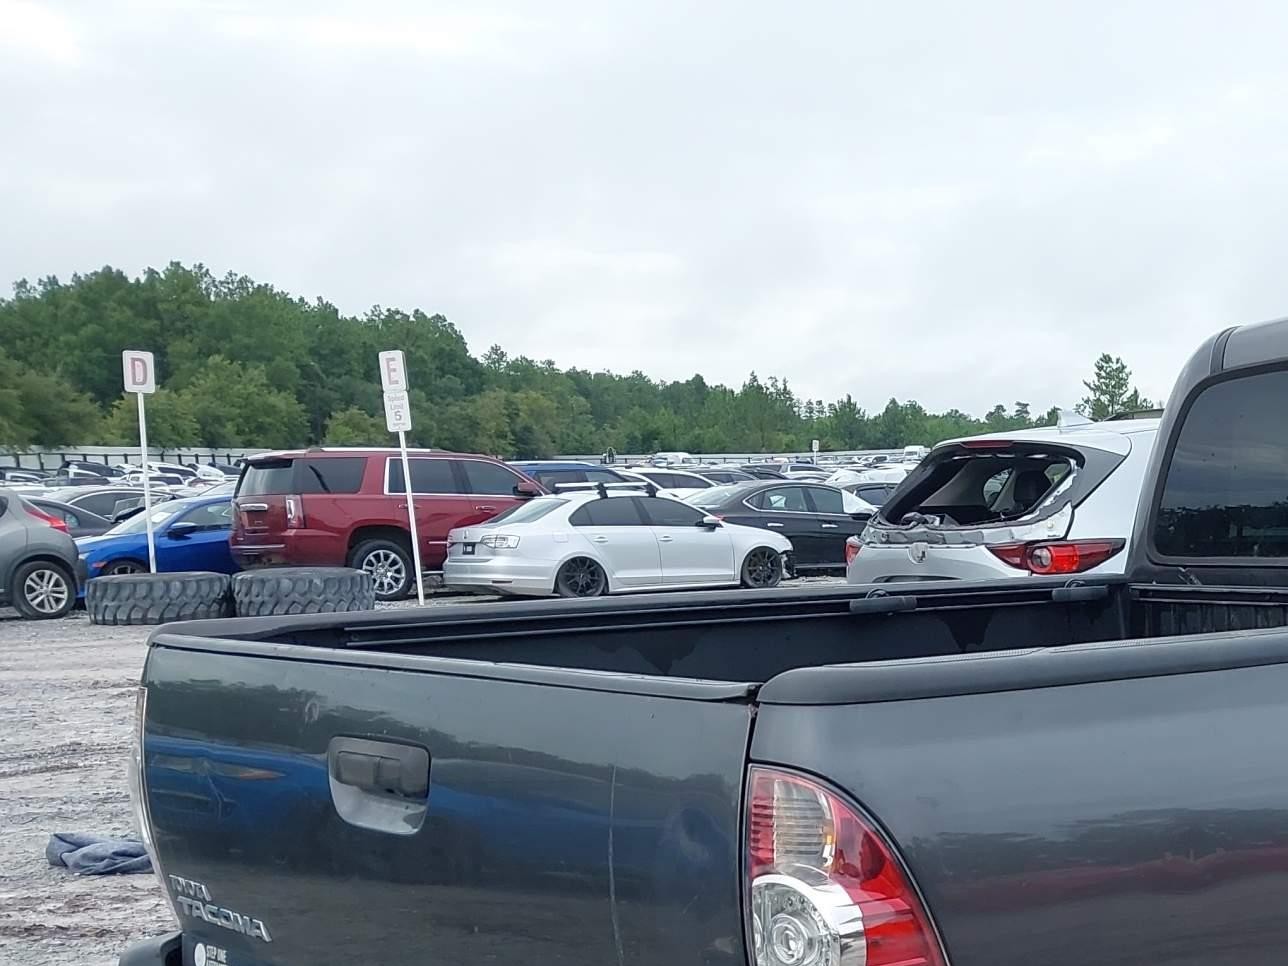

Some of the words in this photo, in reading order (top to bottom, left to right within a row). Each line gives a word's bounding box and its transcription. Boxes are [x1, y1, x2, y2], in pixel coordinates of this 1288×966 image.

[130, 358, 147, 385] D
[385, 358, 399, 385] E
[394, 410, 402, 421] 5
[177, 896, 272, 943] TACOMA
[206, 945, 217, 959] STEP
